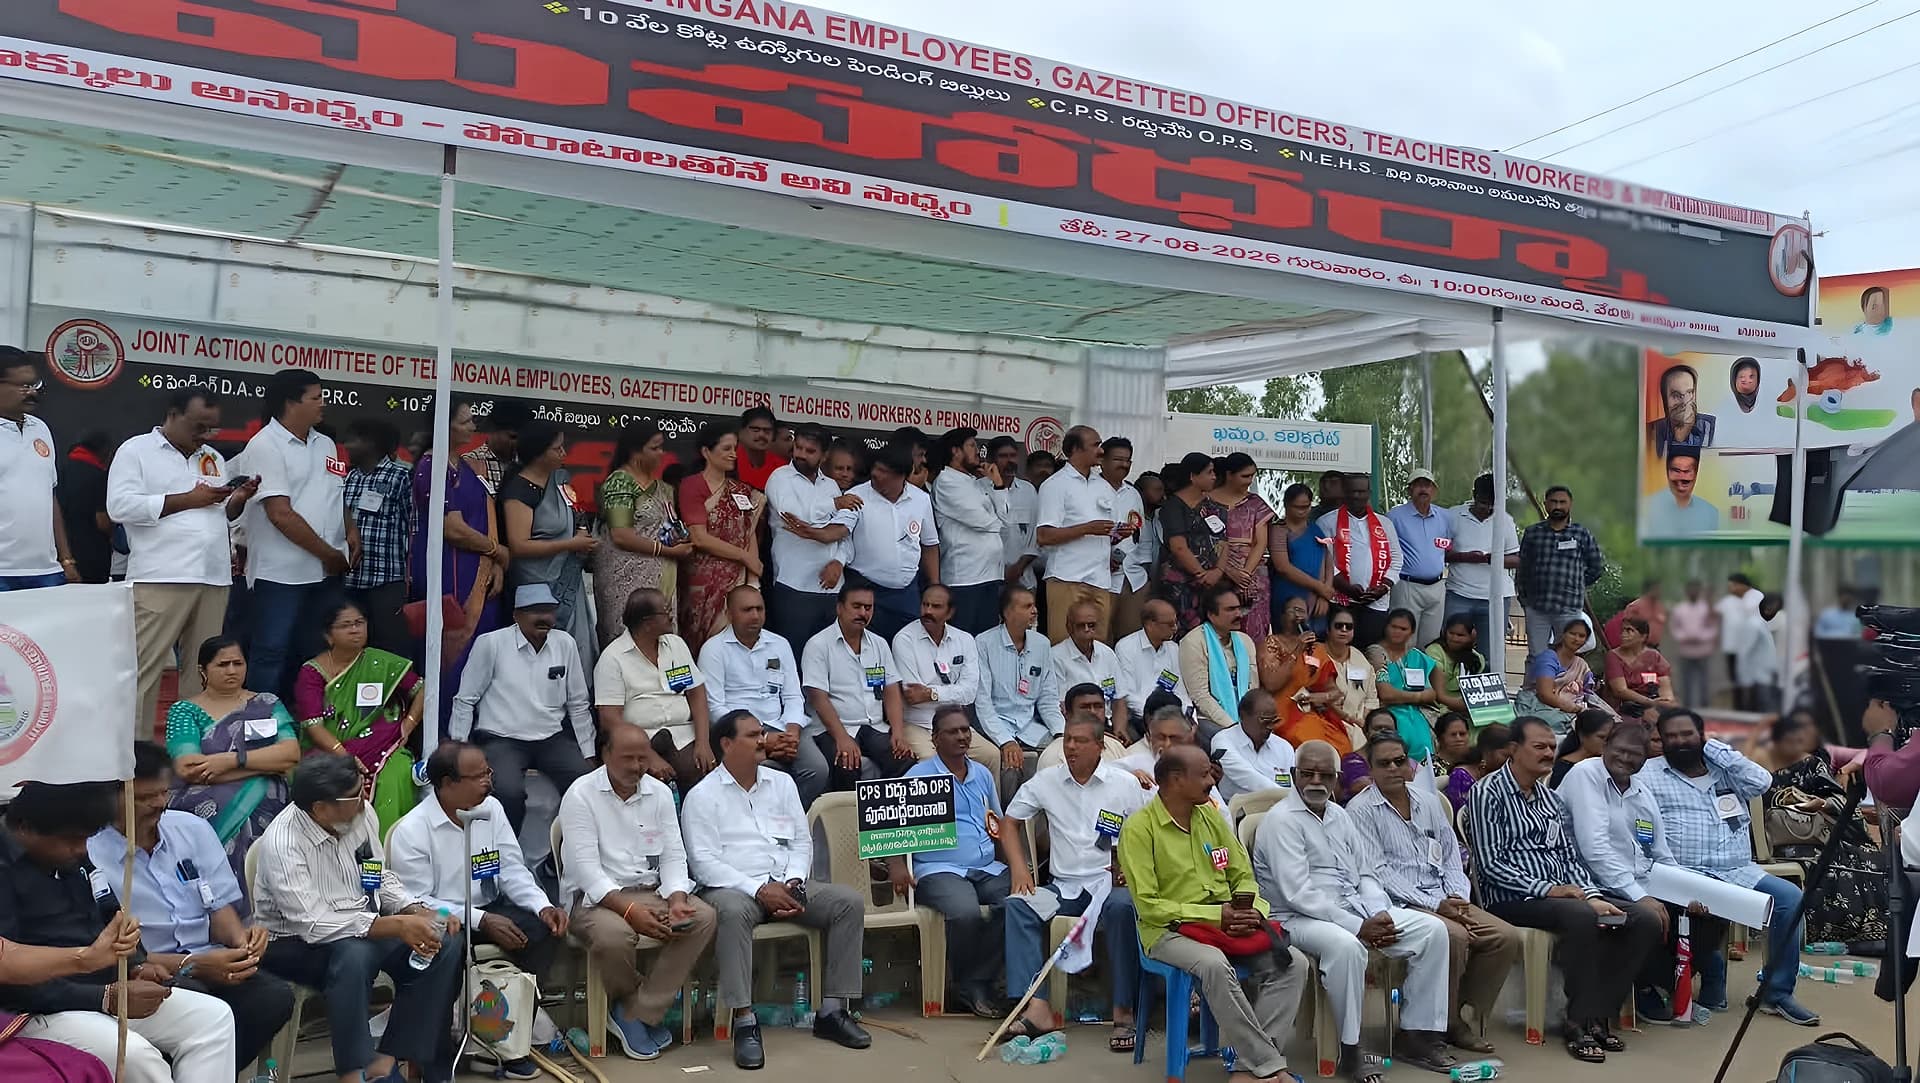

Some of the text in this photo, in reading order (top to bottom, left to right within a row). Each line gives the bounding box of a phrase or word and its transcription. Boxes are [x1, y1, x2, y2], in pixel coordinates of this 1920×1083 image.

[578, 8, 619, 25] 10
[626, 13, 670, 34] వేల
[677, 24, 728, 50] కోట్ల
[735, 37, 842, 66] ఉద్యోగుల
[848, 58, 935, 85] పెండింగ్
[940, 79, 1011, 102] బిల్లులు
[1050, 99, 1114, 124] C.P.S.
[1122, 115, 1193, 139] రద్దుచేసి
[1199, 130, 1258, 153] O.P.S.
[1299, 149, 1376, 175] N.E.H.S.
[825, 15, 1037, 85] EMPLOYEES,
[1052, 66, 1206, 116] GAZETTED
[1216, 102, 1353, 150] OFFICERS,
[191, 80, 403, 130] అసాధ్యం
[463, 123, 769, 184] పోరాటాలతోనే
[780, 172, 852, 196] అవి
[863, 185, 972, 220] సాధ్యం
[1115, 229, 1281, 265] 27-08-2026
[131, 329, 189, 354] JOINT
[195, 337, 265, 362] ACTION
[272, 345, 376, 375] COMMITTEE
[382, 356, 406, 376] OF
[411, 357, 511, 385] TELNGANA
[516, 368, 614, 399] EMPLOYEES,
[621, 378, 699, 404] GAZETTED
[780, 395, 853, 423] TEACHERS,
[857, 404, 921, 426] WORKERS
[924, 410, 933, 427] &
[937, 411, 1021, 434] PENSIONNERS
[152, 374, 163, 389] 6
[221, 379, 253, 397] D.A.
[859, 785, 881, 801] CPS
[929, 778, 951, 795] OPS
